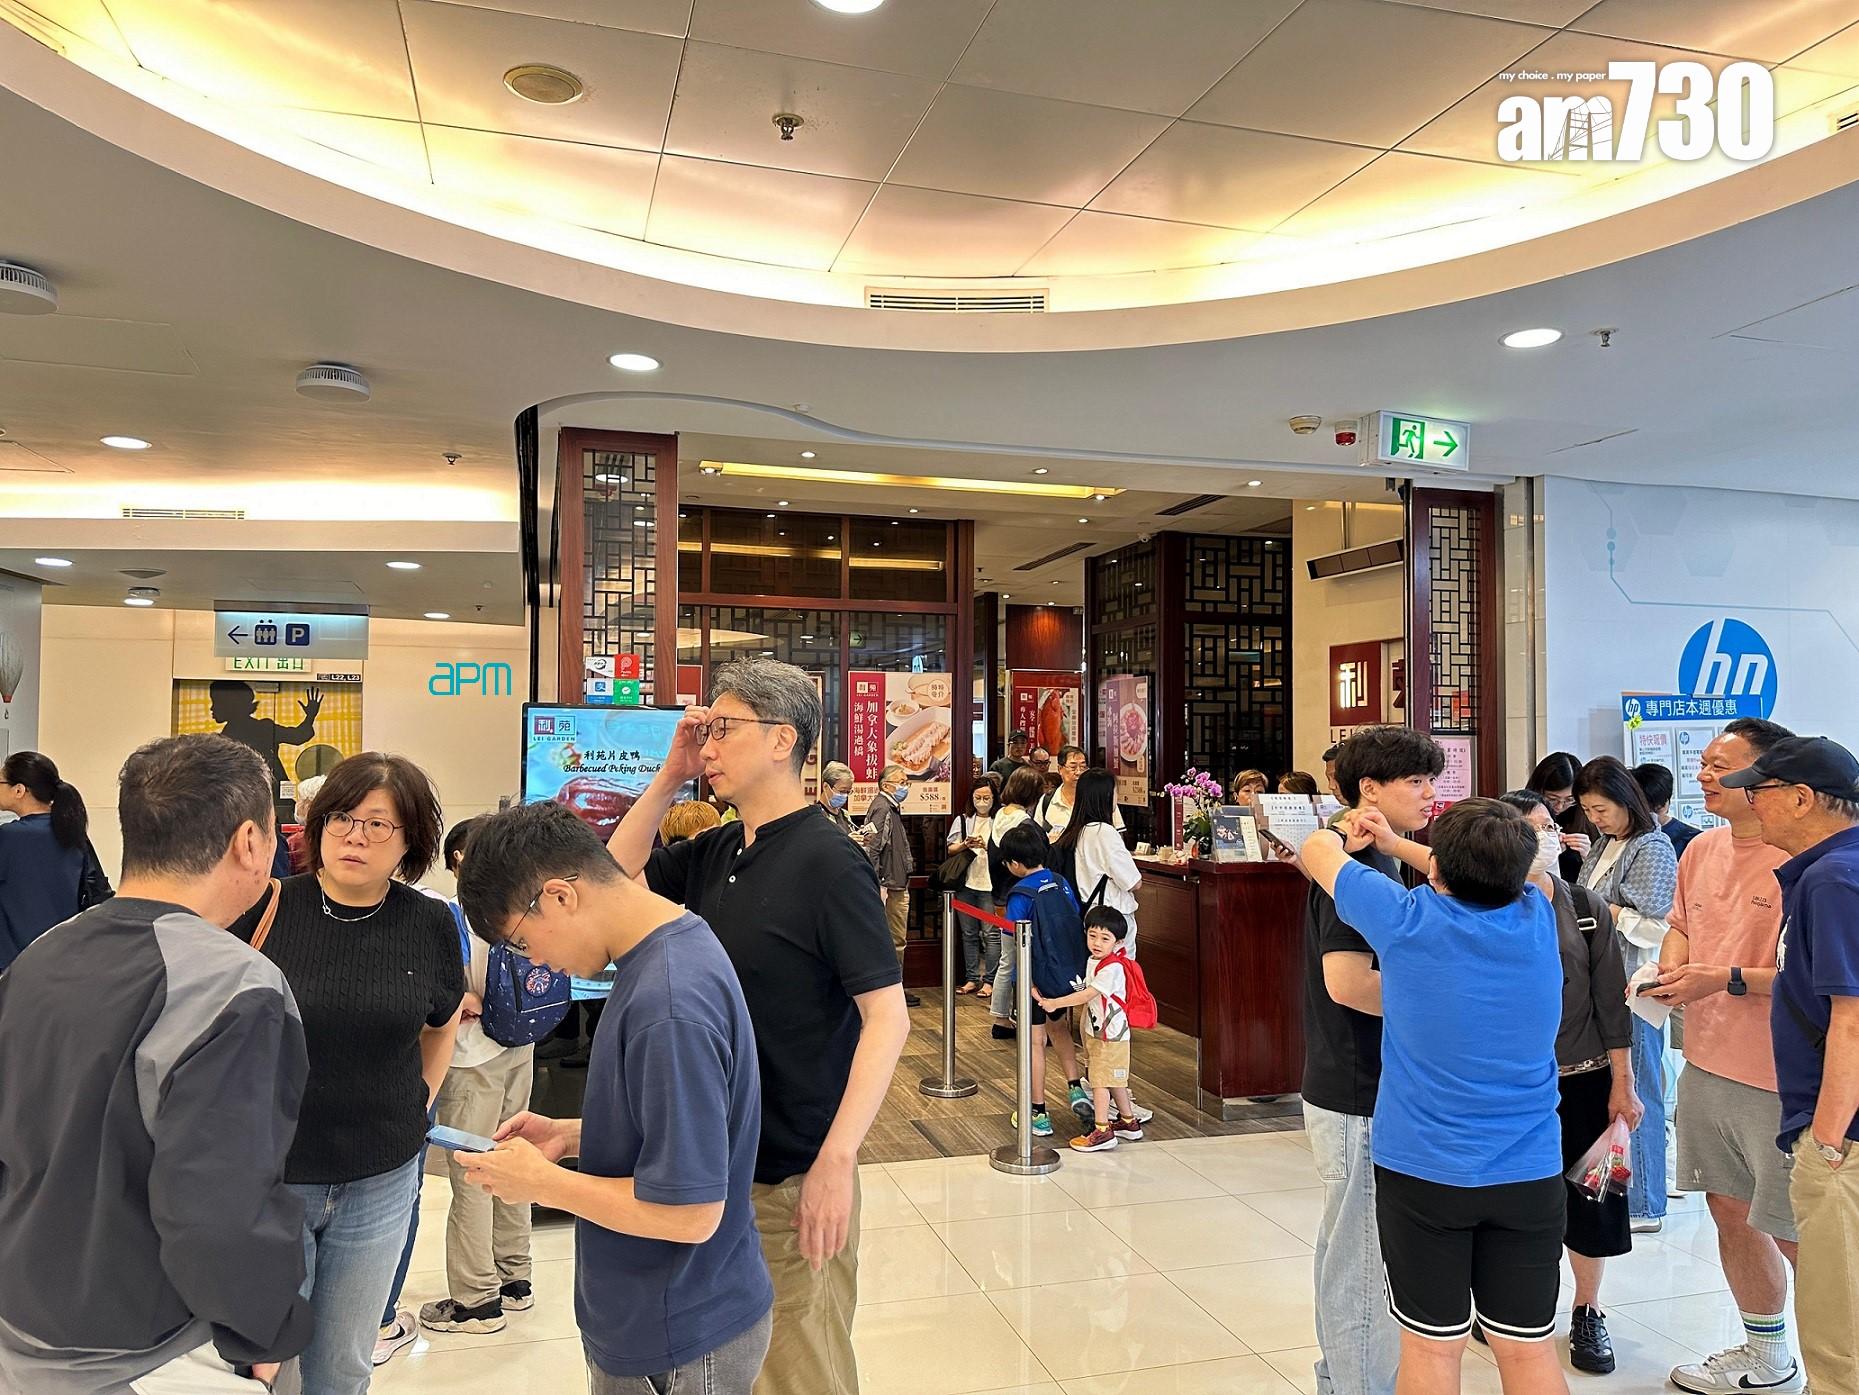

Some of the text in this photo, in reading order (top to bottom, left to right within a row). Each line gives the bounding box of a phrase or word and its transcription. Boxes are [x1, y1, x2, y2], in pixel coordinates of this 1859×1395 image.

[291, 627, 305, 643] P
[1627, 698, 1640, 716] hp
[1645, 699, 1738, 716] 專門店本週優惠
[583, 750, 641, 761] 利苑片皮鴨
[563, 763, 607, 773] Barbecued
[638, 763, 661, 773] Duck
